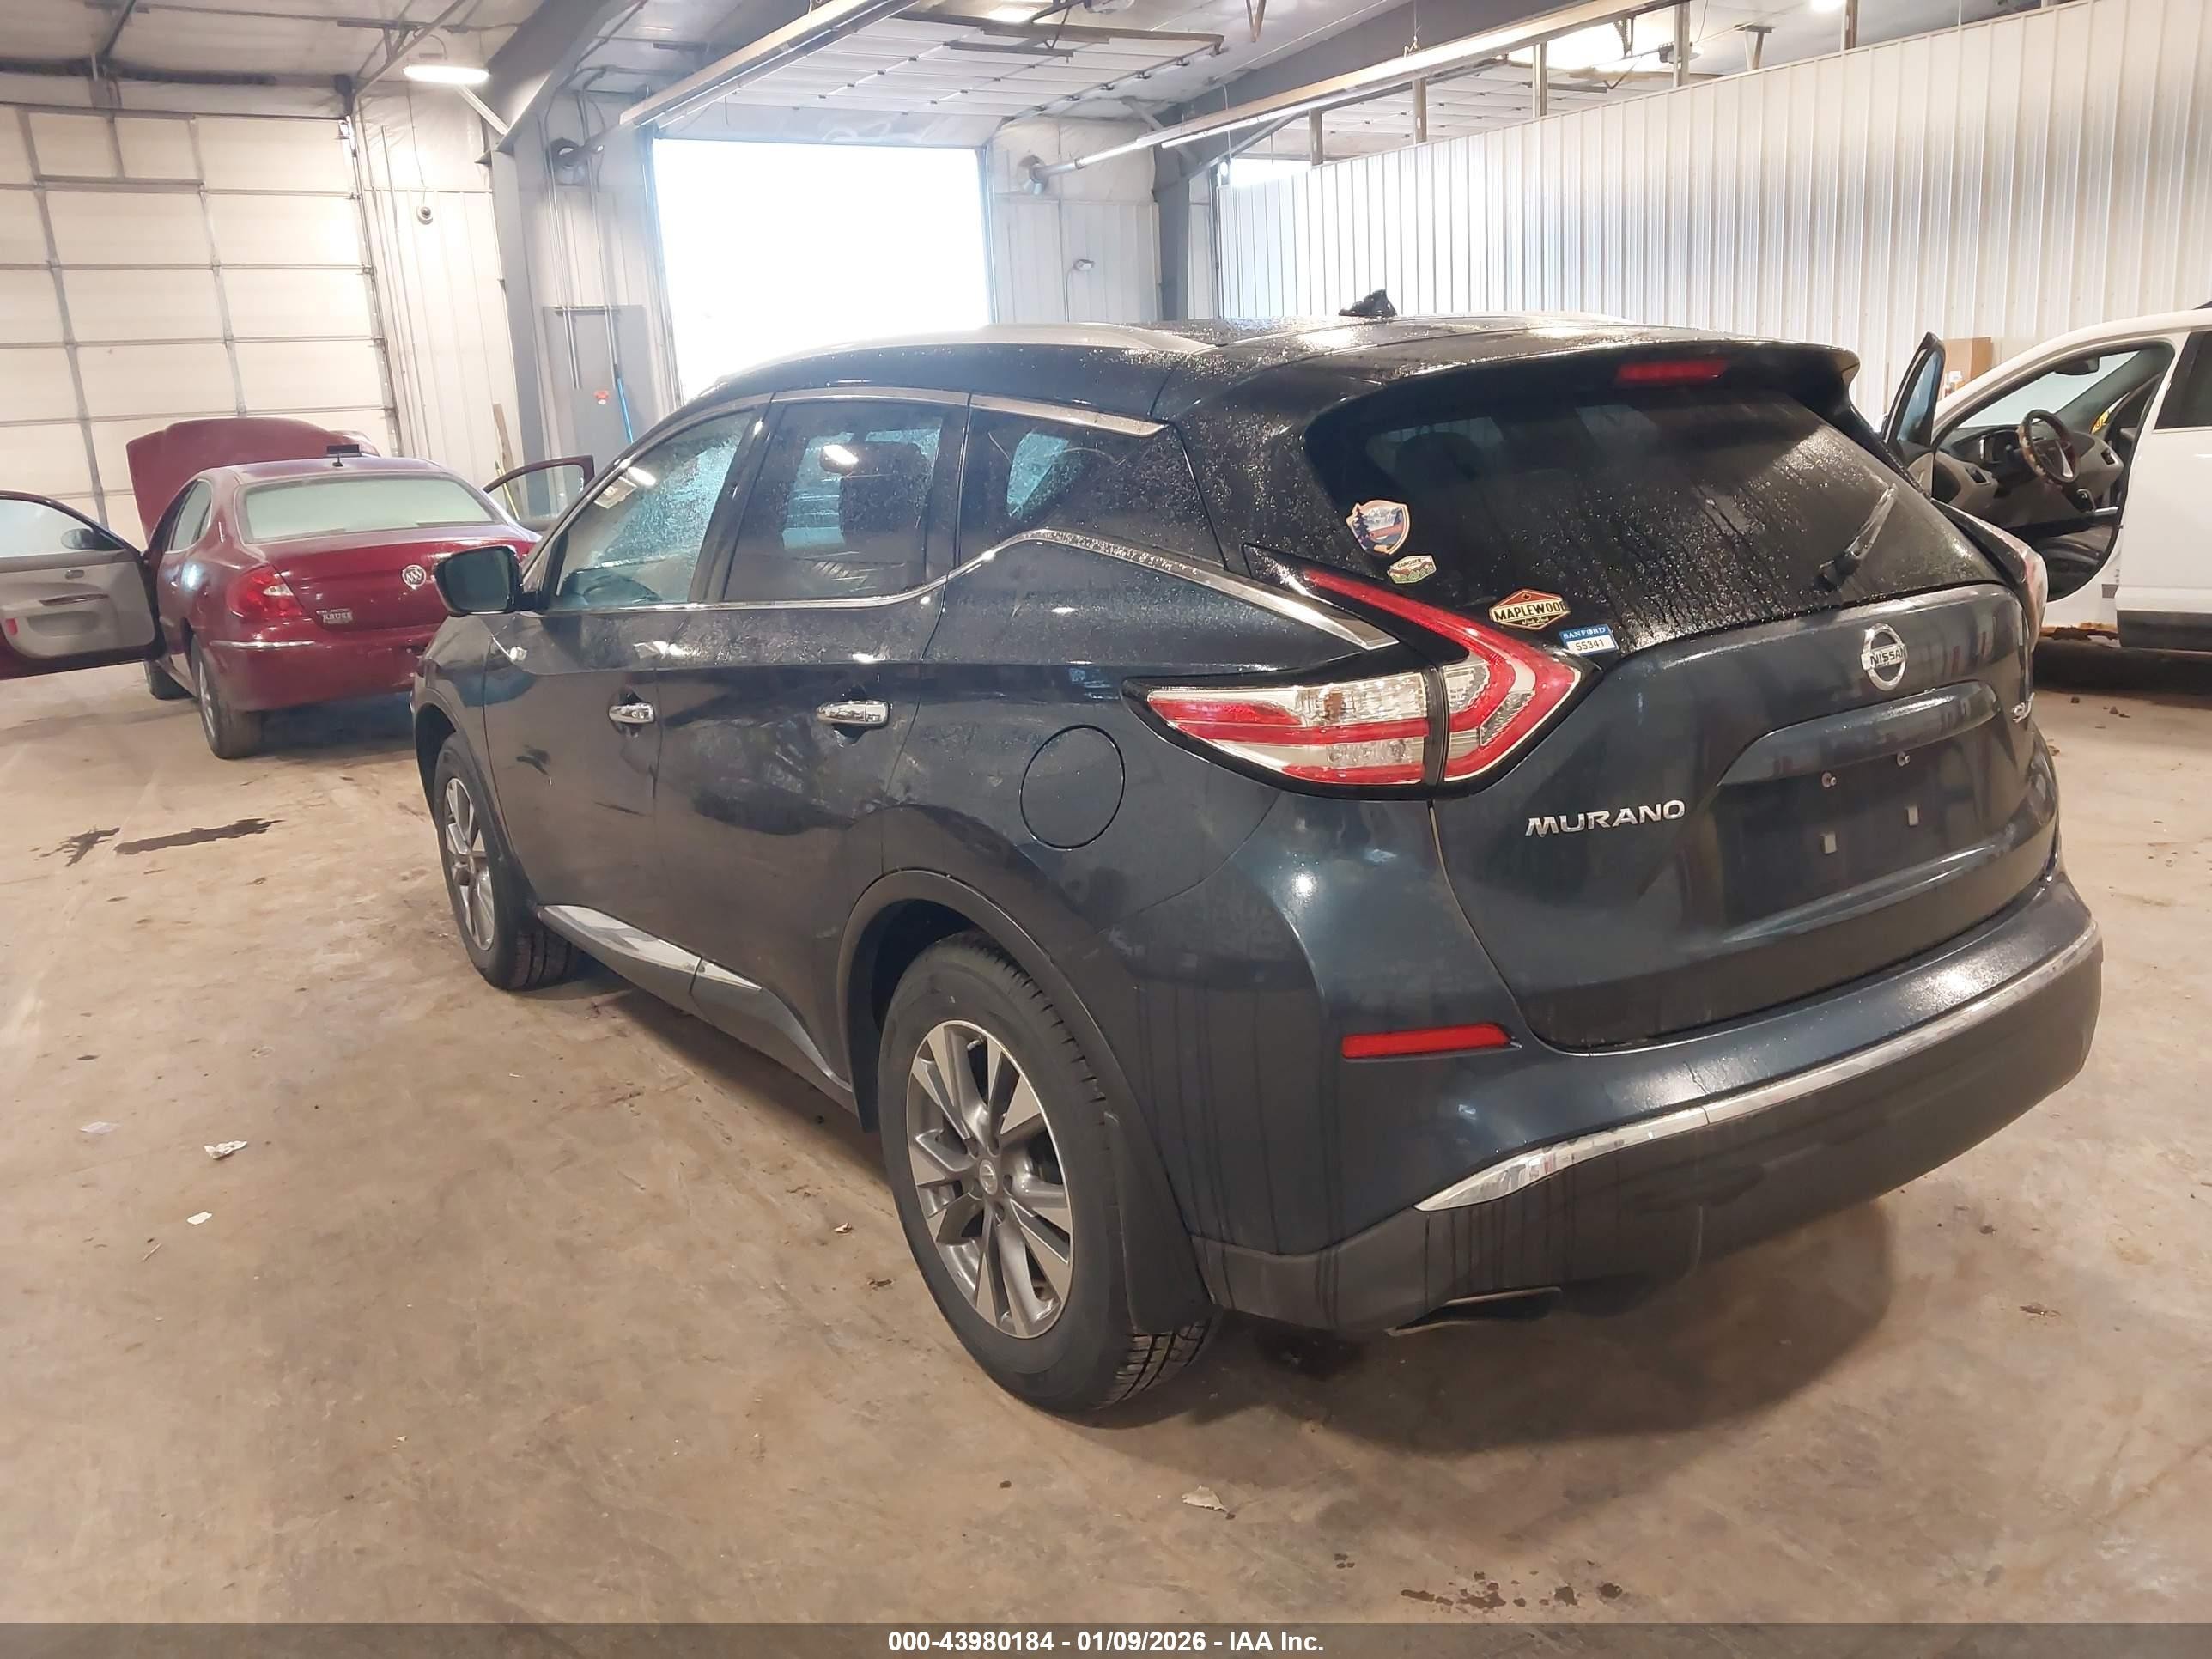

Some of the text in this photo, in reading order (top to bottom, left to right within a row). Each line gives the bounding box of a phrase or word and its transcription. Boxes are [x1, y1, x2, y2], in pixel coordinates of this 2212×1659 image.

[1493, 601, 1566, 621] MAPLEWOOD
[1563, 627, 1606, 640] SANFORD
[1575, 638, 1605, 652] 55341
[1869, 645, 1905, 665] NISSAN
[1525, 799, 1686, 838] MURANO
